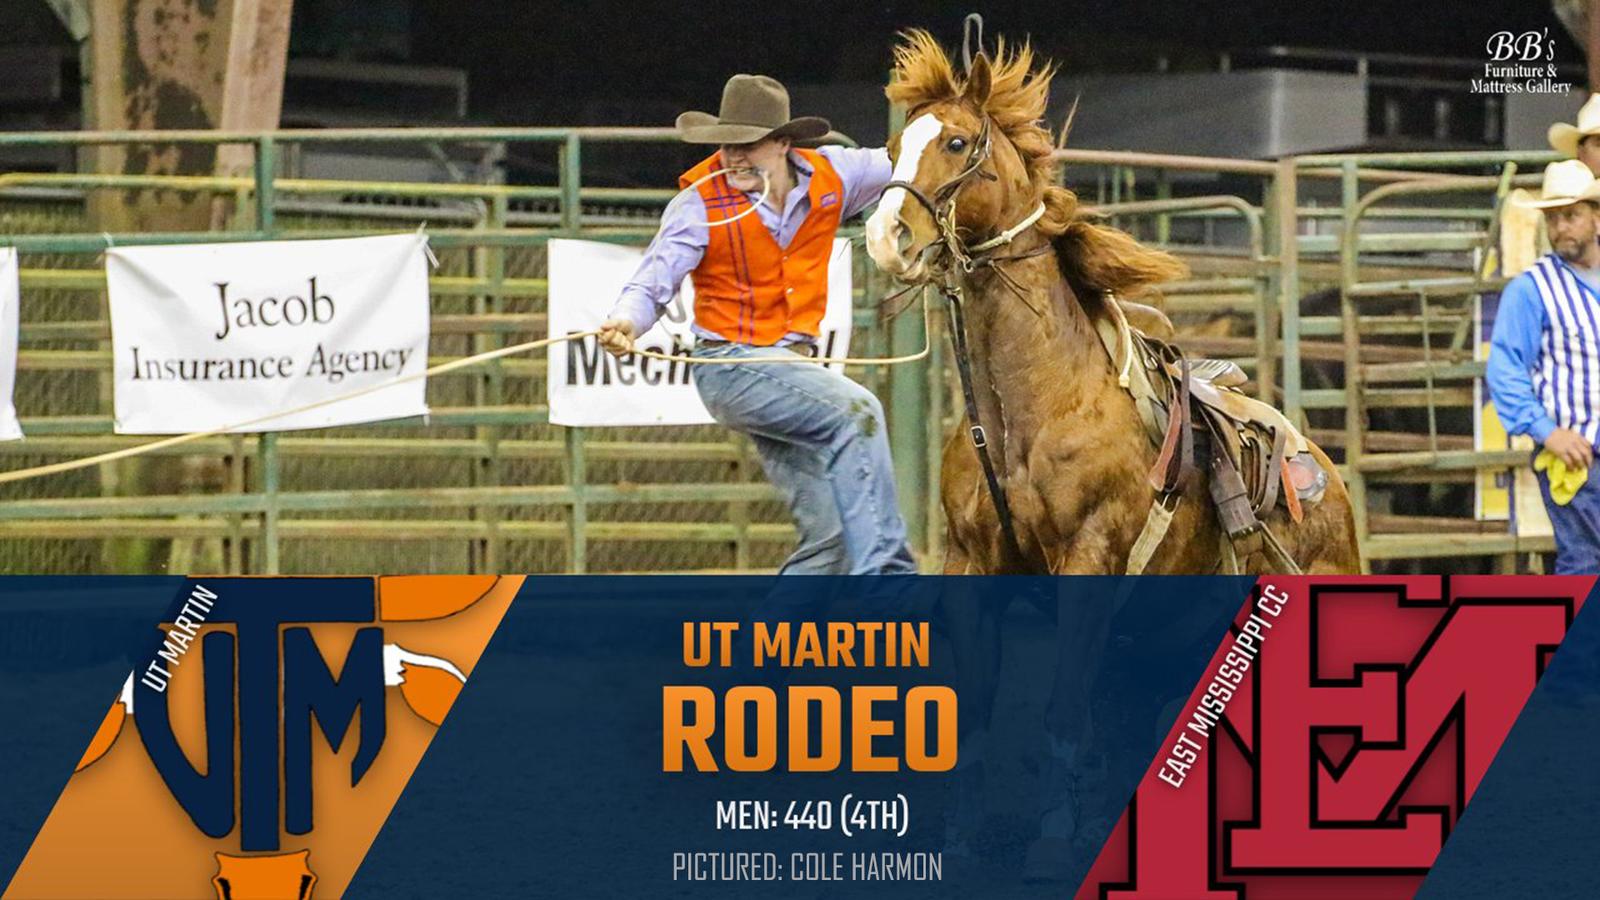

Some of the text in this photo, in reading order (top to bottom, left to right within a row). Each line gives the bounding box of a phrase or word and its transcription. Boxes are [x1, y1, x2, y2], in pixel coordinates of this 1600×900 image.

[213, 276, 335, 340] Jacob
[130, 343, 414, 383] Insurance Agency
